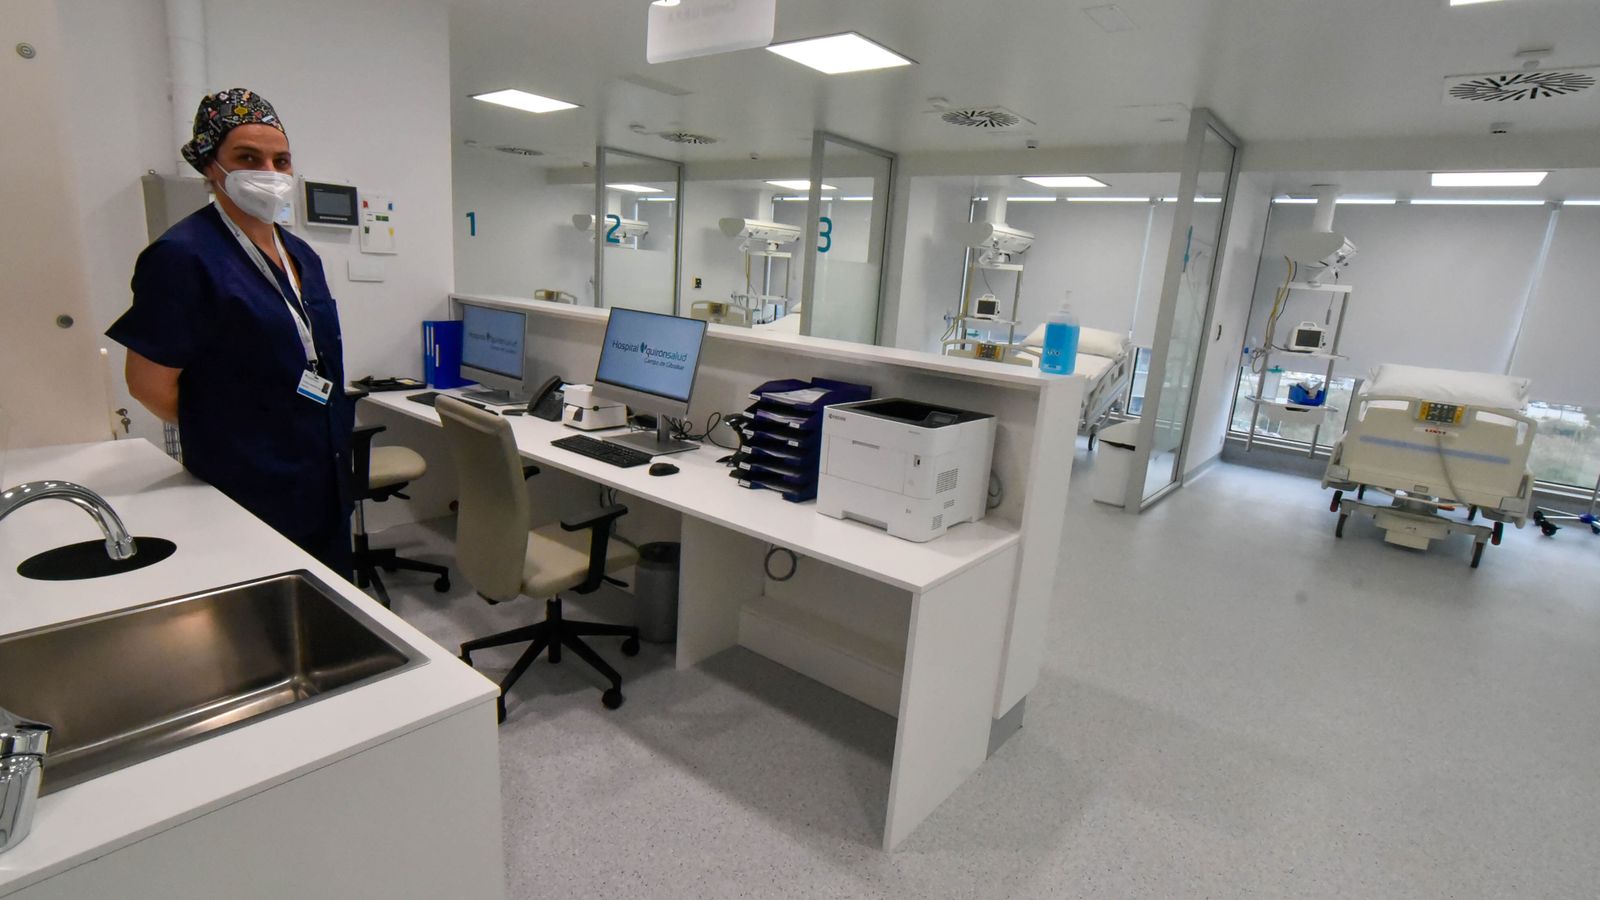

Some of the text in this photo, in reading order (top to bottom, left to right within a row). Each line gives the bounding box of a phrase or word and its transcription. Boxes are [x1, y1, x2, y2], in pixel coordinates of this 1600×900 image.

[466, 211, 476, 237] 1
[606, 214, 621, 244] 2
[817, 216, 833, 253] 3
[612, 340, 639, 353] Hospital
